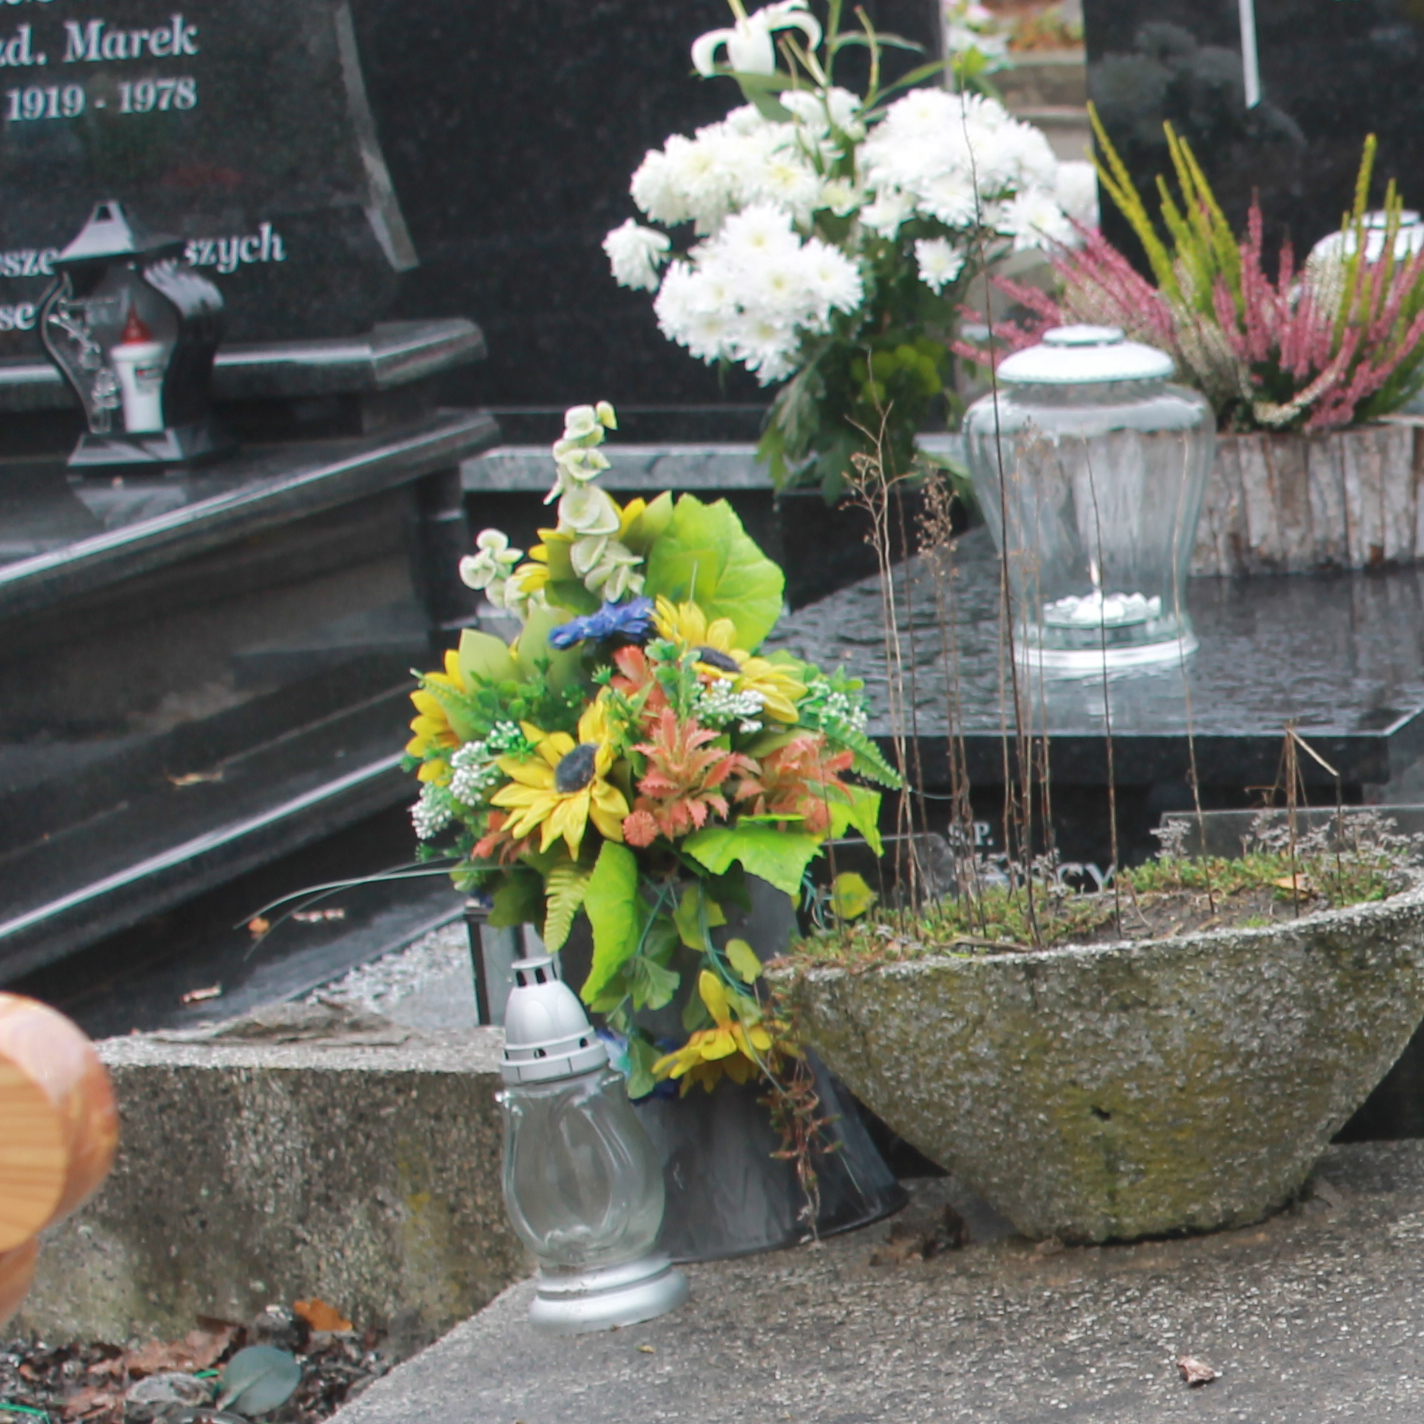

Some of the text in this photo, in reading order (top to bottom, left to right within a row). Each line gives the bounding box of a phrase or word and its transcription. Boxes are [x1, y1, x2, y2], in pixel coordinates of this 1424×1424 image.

[62, 13, 199, 63] Marek
[6, 83, 86, 121] 1919
[117, 76, 198, 114] 1978
